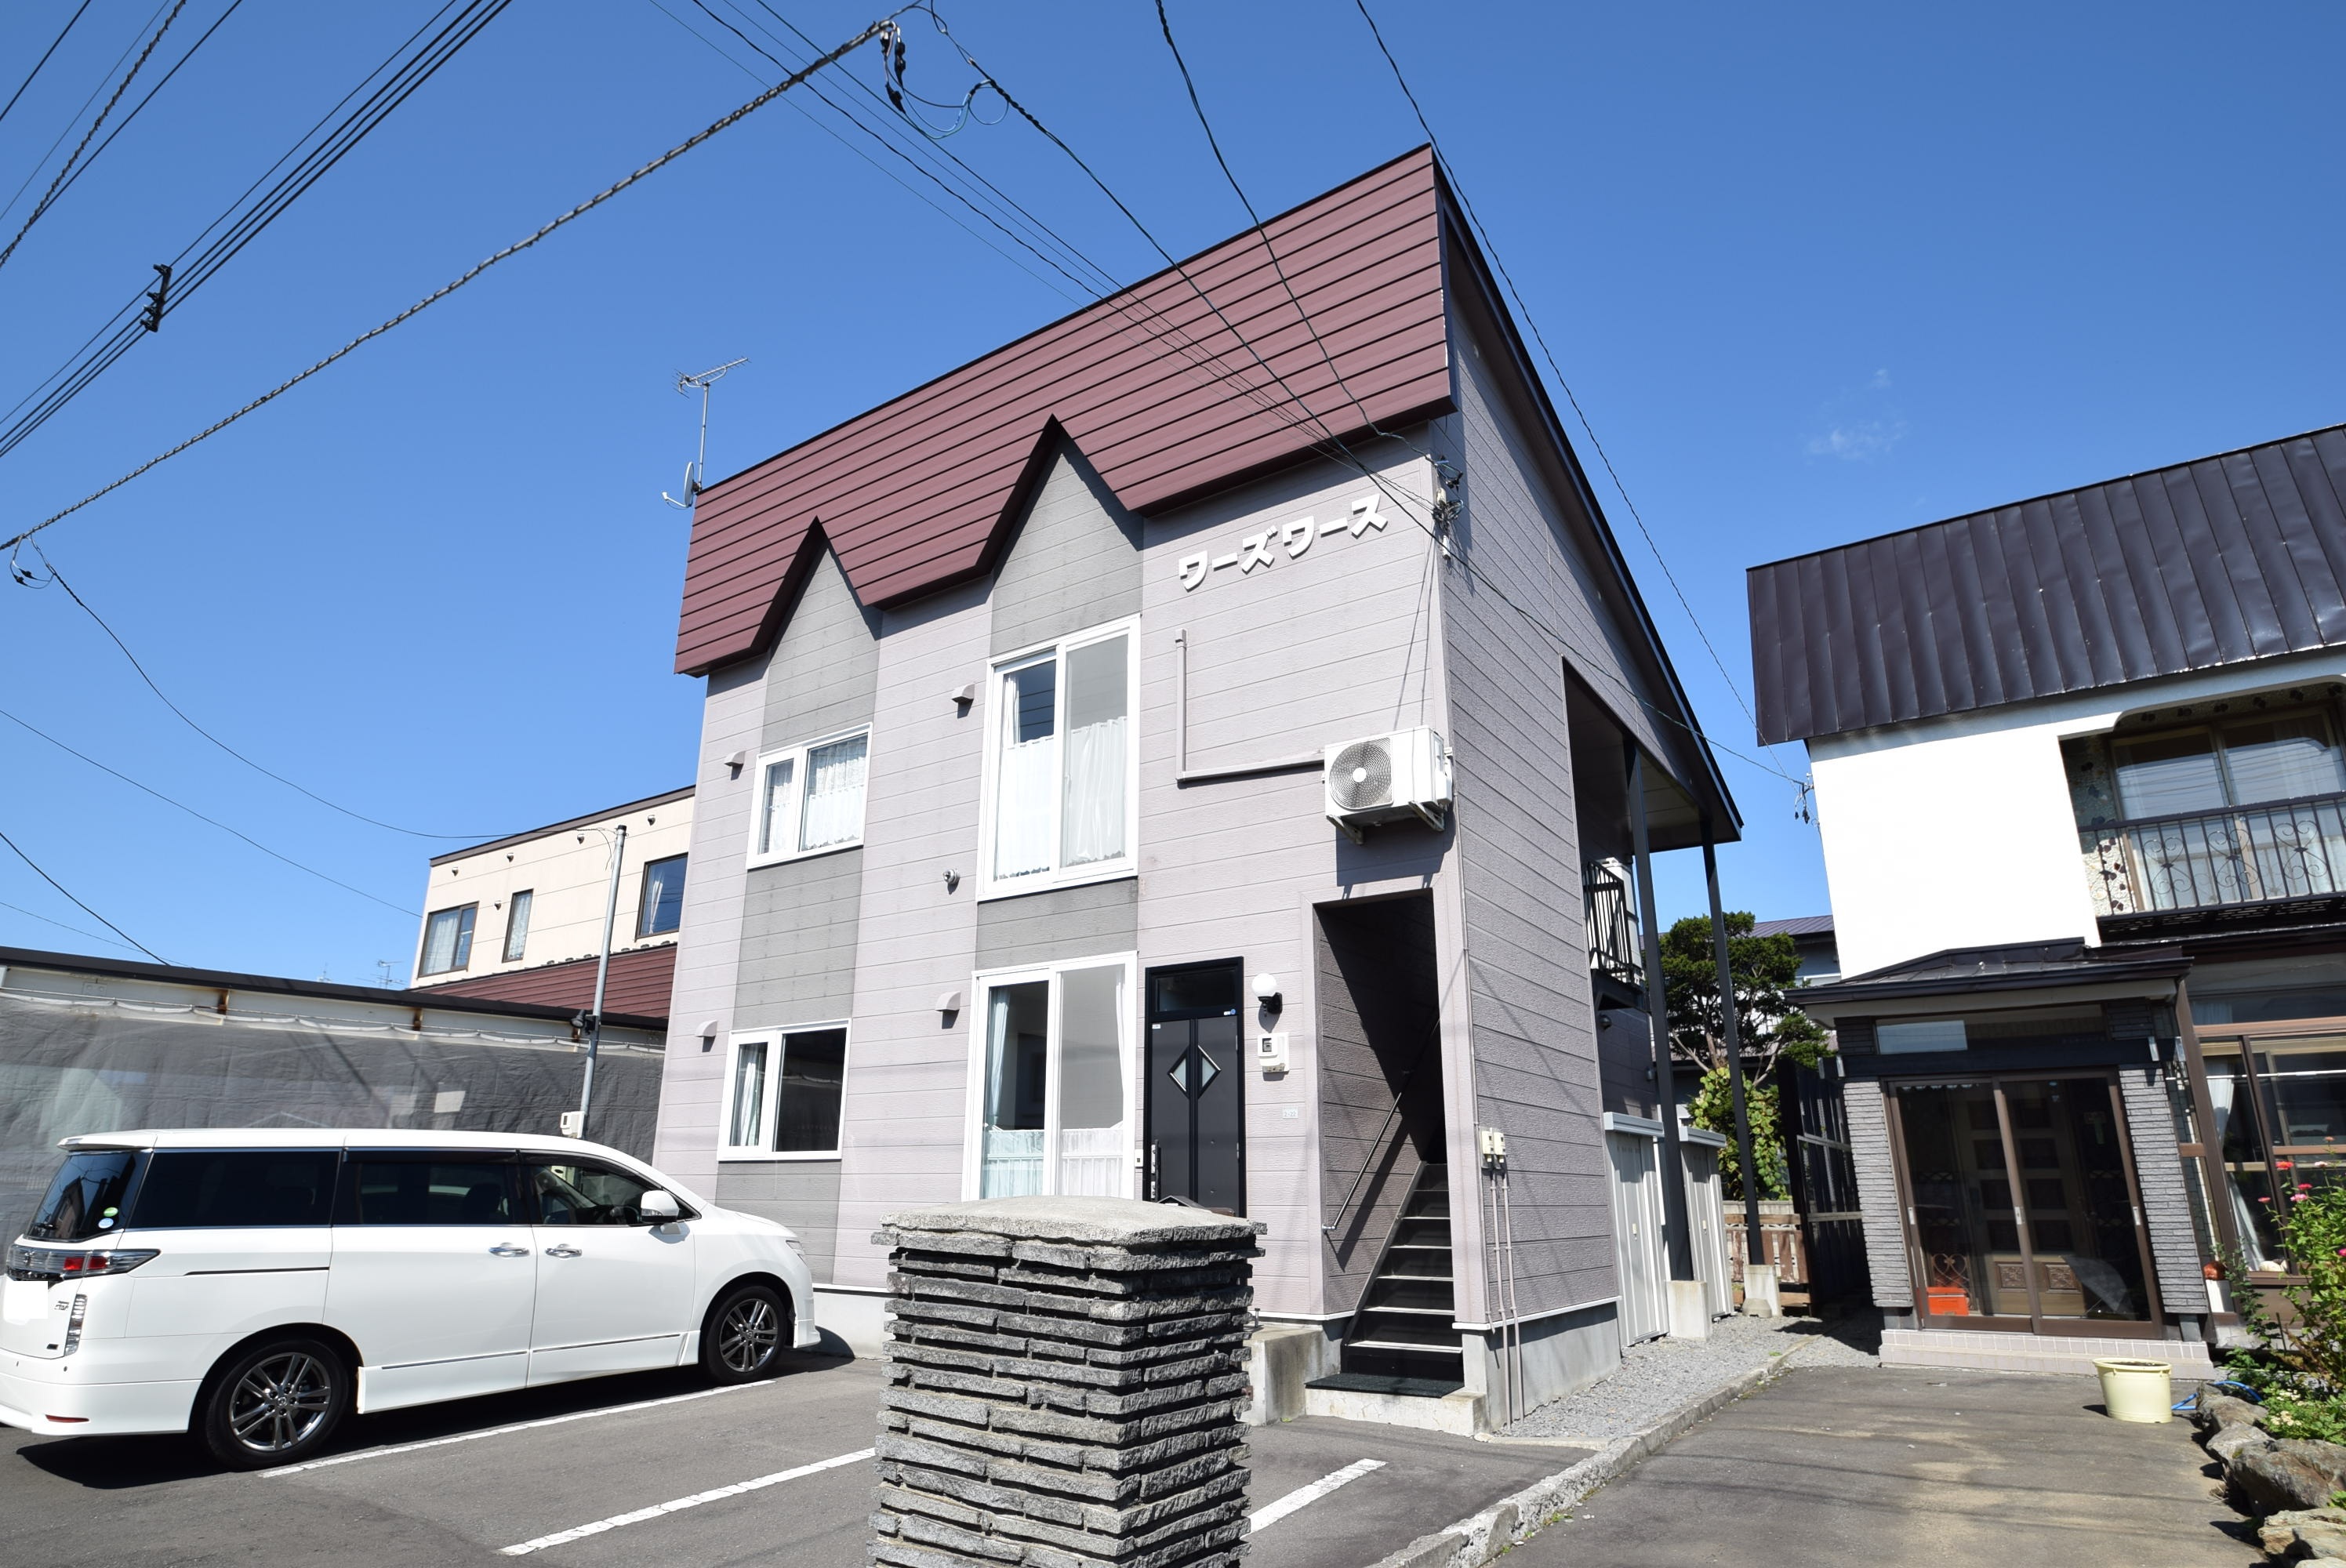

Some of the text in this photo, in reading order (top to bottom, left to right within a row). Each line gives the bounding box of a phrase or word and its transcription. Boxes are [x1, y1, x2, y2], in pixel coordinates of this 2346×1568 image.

[1178, 493, 1388, 591] ワーズワース
